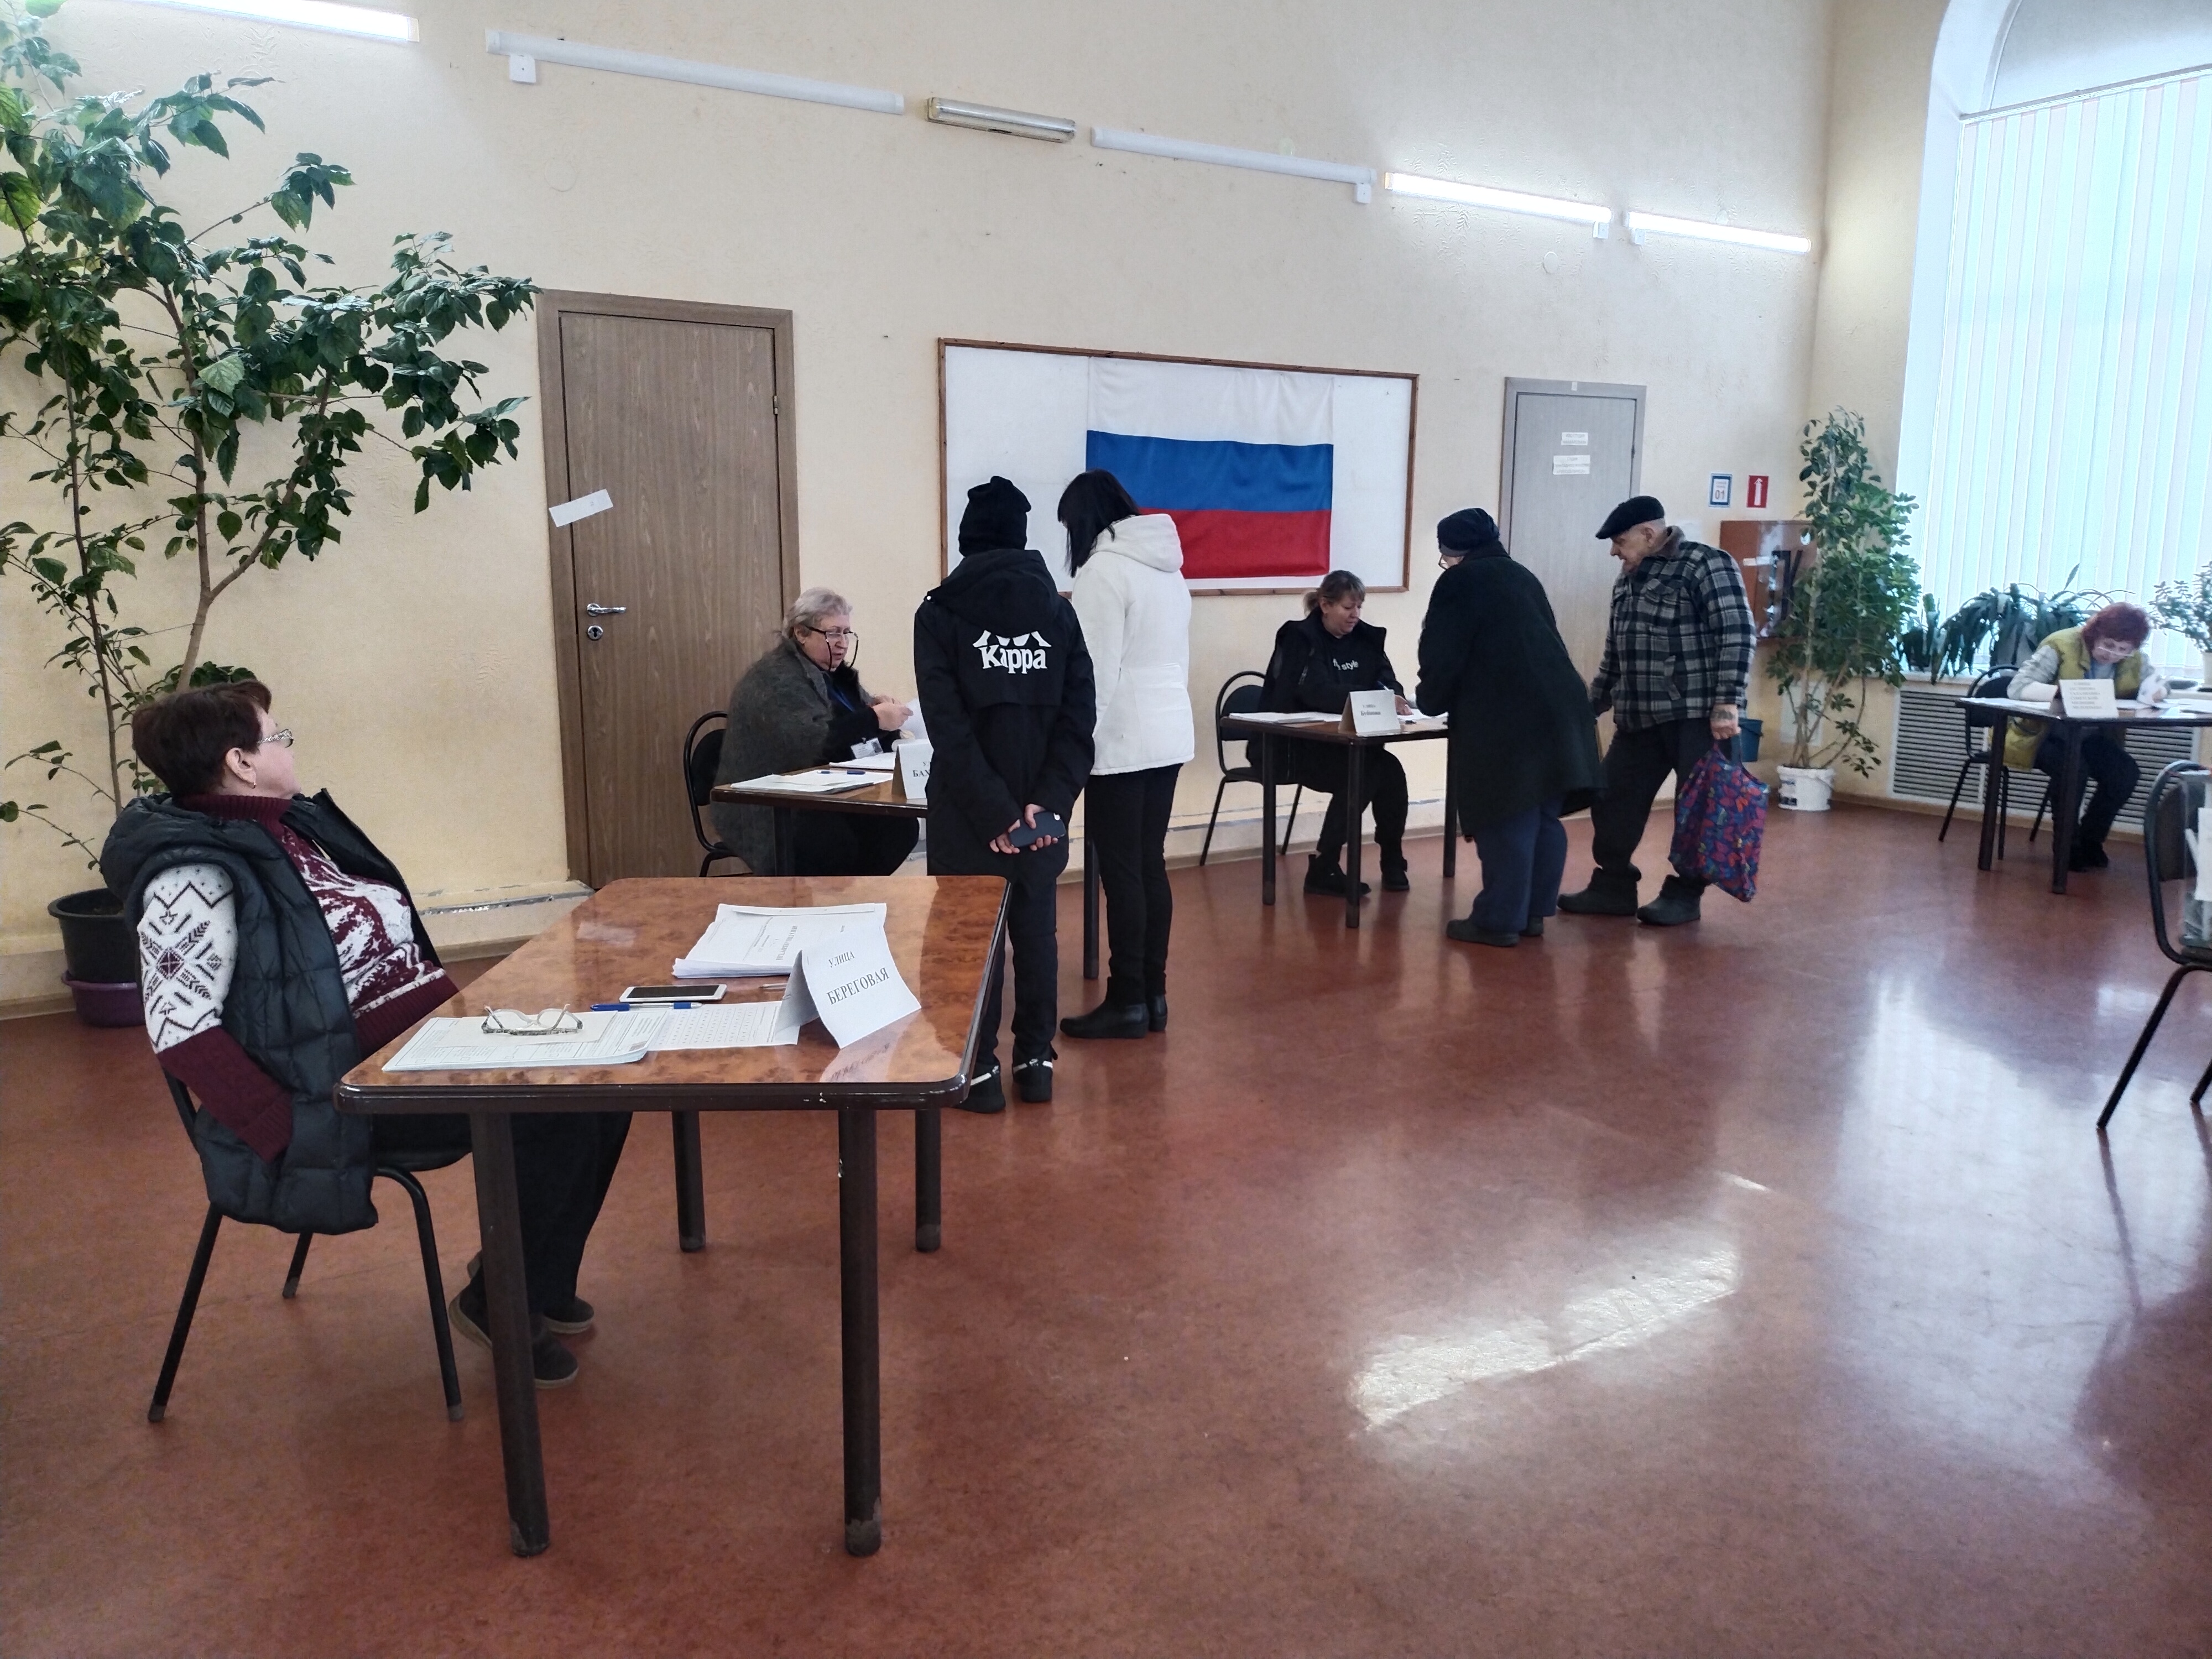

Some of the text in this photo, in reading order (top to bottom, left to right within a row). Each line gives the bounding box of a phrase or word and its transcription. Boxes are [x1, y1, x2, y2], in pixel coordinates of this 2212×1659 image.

[1715, 489, 1725, 499] 01
[978, 644, 1048, 674] Kappa
[828, 951, 855, 968] УЛИЦА
[826, 967, 890, 1005] БЕРЕГОВАЯ
